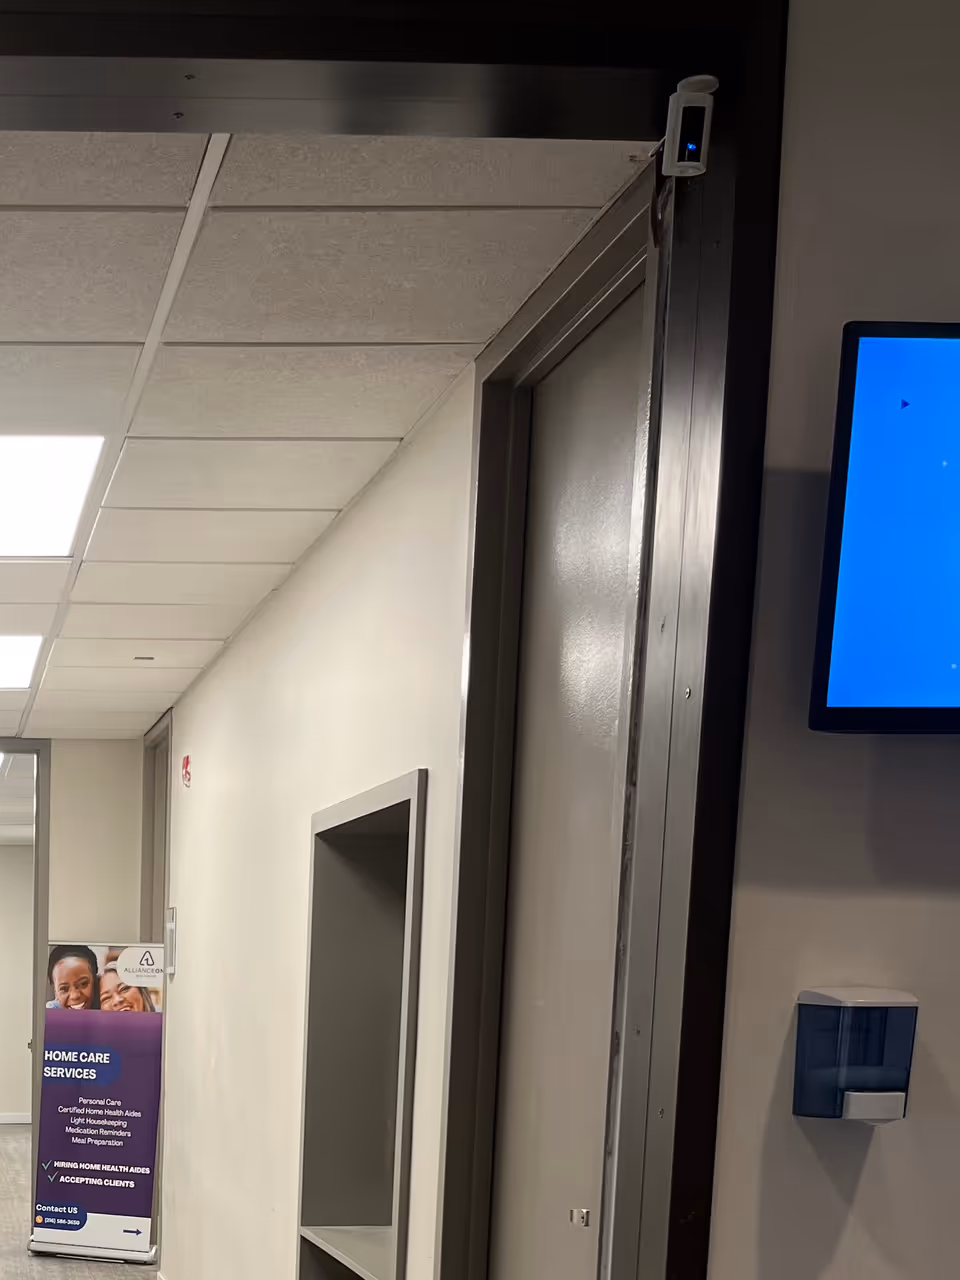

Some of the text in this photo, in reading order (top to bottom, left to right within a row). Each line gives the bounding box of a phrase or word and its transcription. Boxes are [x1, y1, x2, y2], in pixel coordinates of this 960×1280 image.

[45, 1050, 110, 1063] HOME CARE
[43, 1066, 97, 1080] SERVICES
[79, 1097, 105, 1105] Personal
[58, 1106, 85, 1114] Certified
[105, 1109, 124, 1117] Health
[70, 1117, 127, 1128] Light Housekeeping
[65, 1126, 131, 1137] Medication Reminders
[87, 1138, 124, 1147] Preparation
[54, 1161, 78, 1169] HIRING
[79, 1163, 101, 1171] HOME
[102, 1164, 128, 1173] HEALTH
[59, 1176, 135, 1188] ACCEPTING CLIENTS
[36, 1204, 67, 1213] Contact
